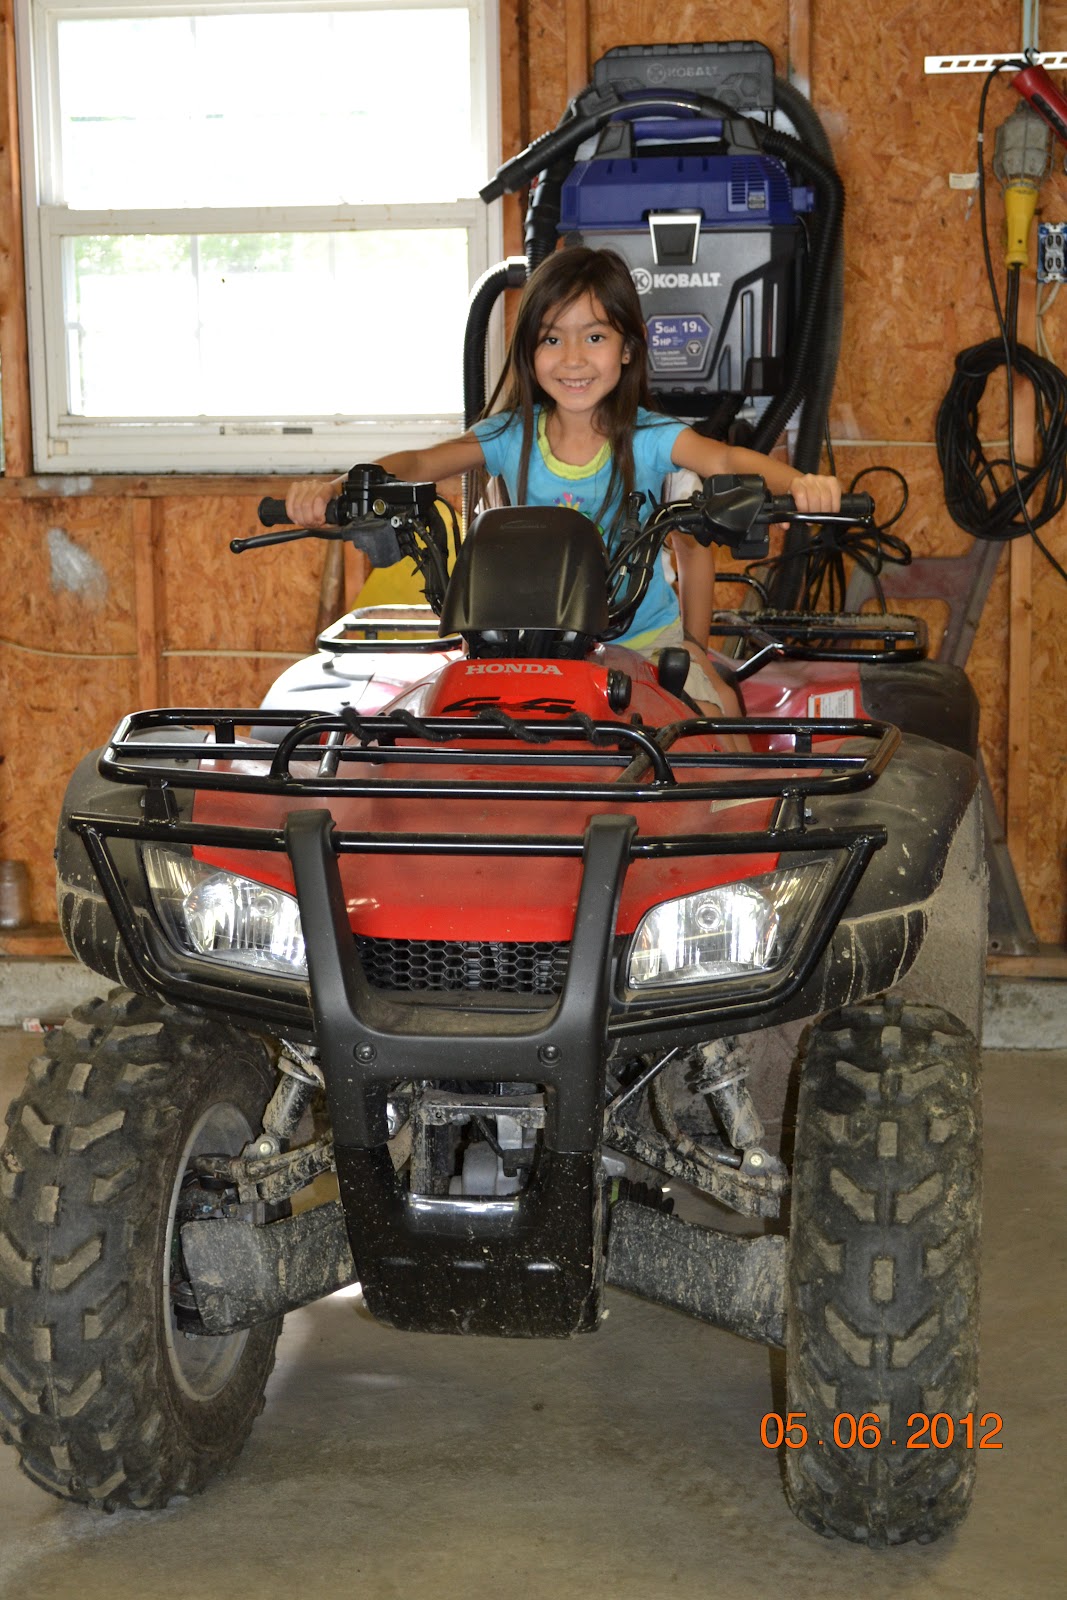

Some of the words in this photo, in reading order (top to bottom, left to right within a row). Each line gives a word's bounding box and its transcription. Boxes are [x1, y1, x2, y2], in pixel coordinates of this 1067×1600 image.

[667, 66, 719, 78] KOBALT
[653, 272, 721, 288] KOBALT
[464, 663, 564, 675] HONDA
